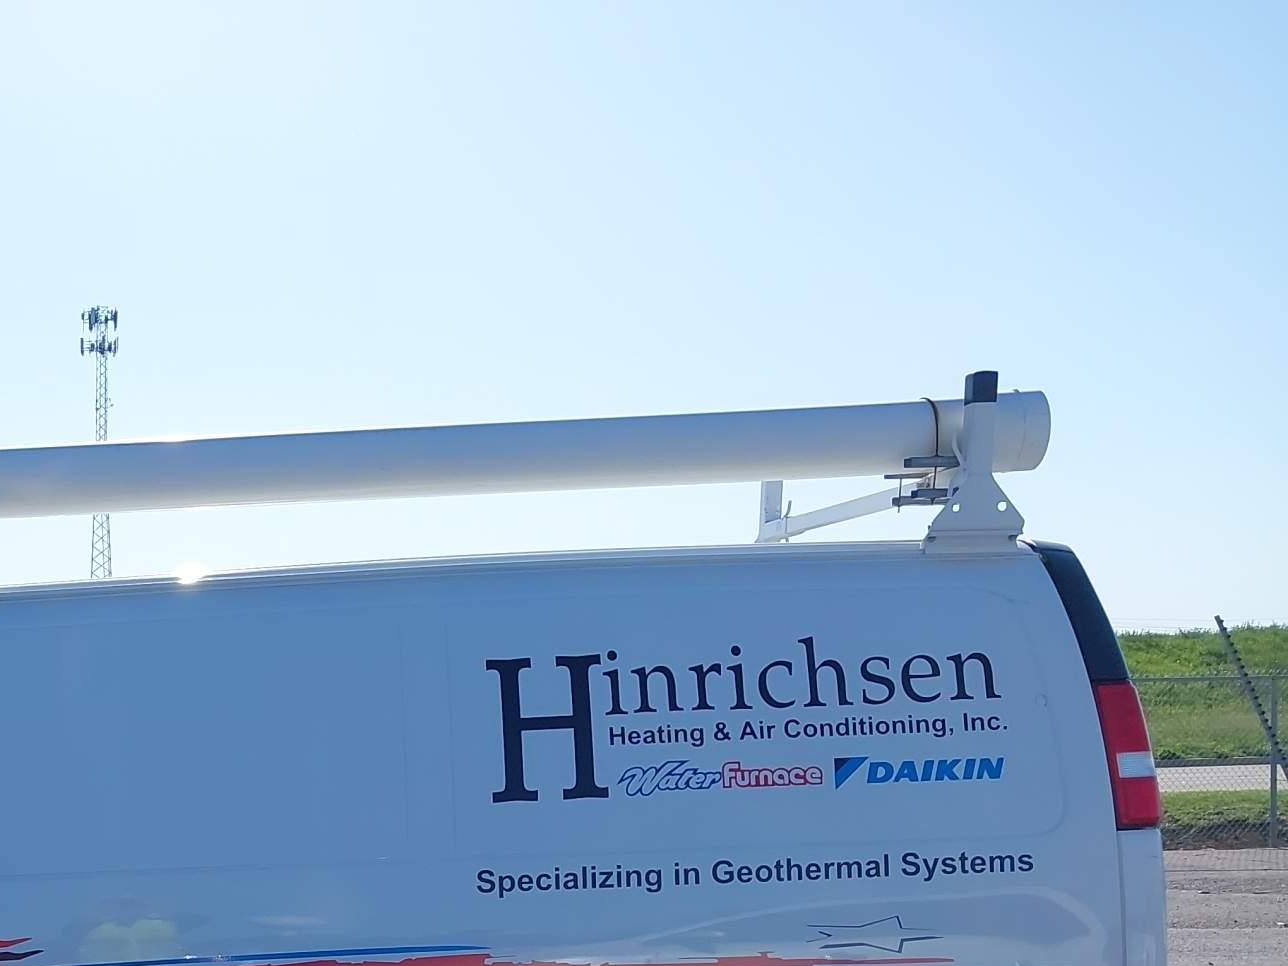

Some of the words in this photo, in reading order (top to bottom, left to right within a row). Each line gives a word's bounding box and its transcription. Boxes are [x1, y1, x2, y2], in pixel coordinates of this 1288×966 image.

[485, 636, 1002, 804] Hinrichsen
[608, 724, 705, 748] Heating
[713, 721, 732, 741] &
[739, 720, 776, 741] Air
[783, 714, 954, 739] Conditioning,
[963, 712, 1008, 732] Inc.
[866, 757, 1005, 784] DAIKIN
[476, 865, 662, 899] Specializing
[674, 862, 700, 886] in
[711, 853, 890, 884] Geothermal
[901, 851, 1034, 882] Systems
